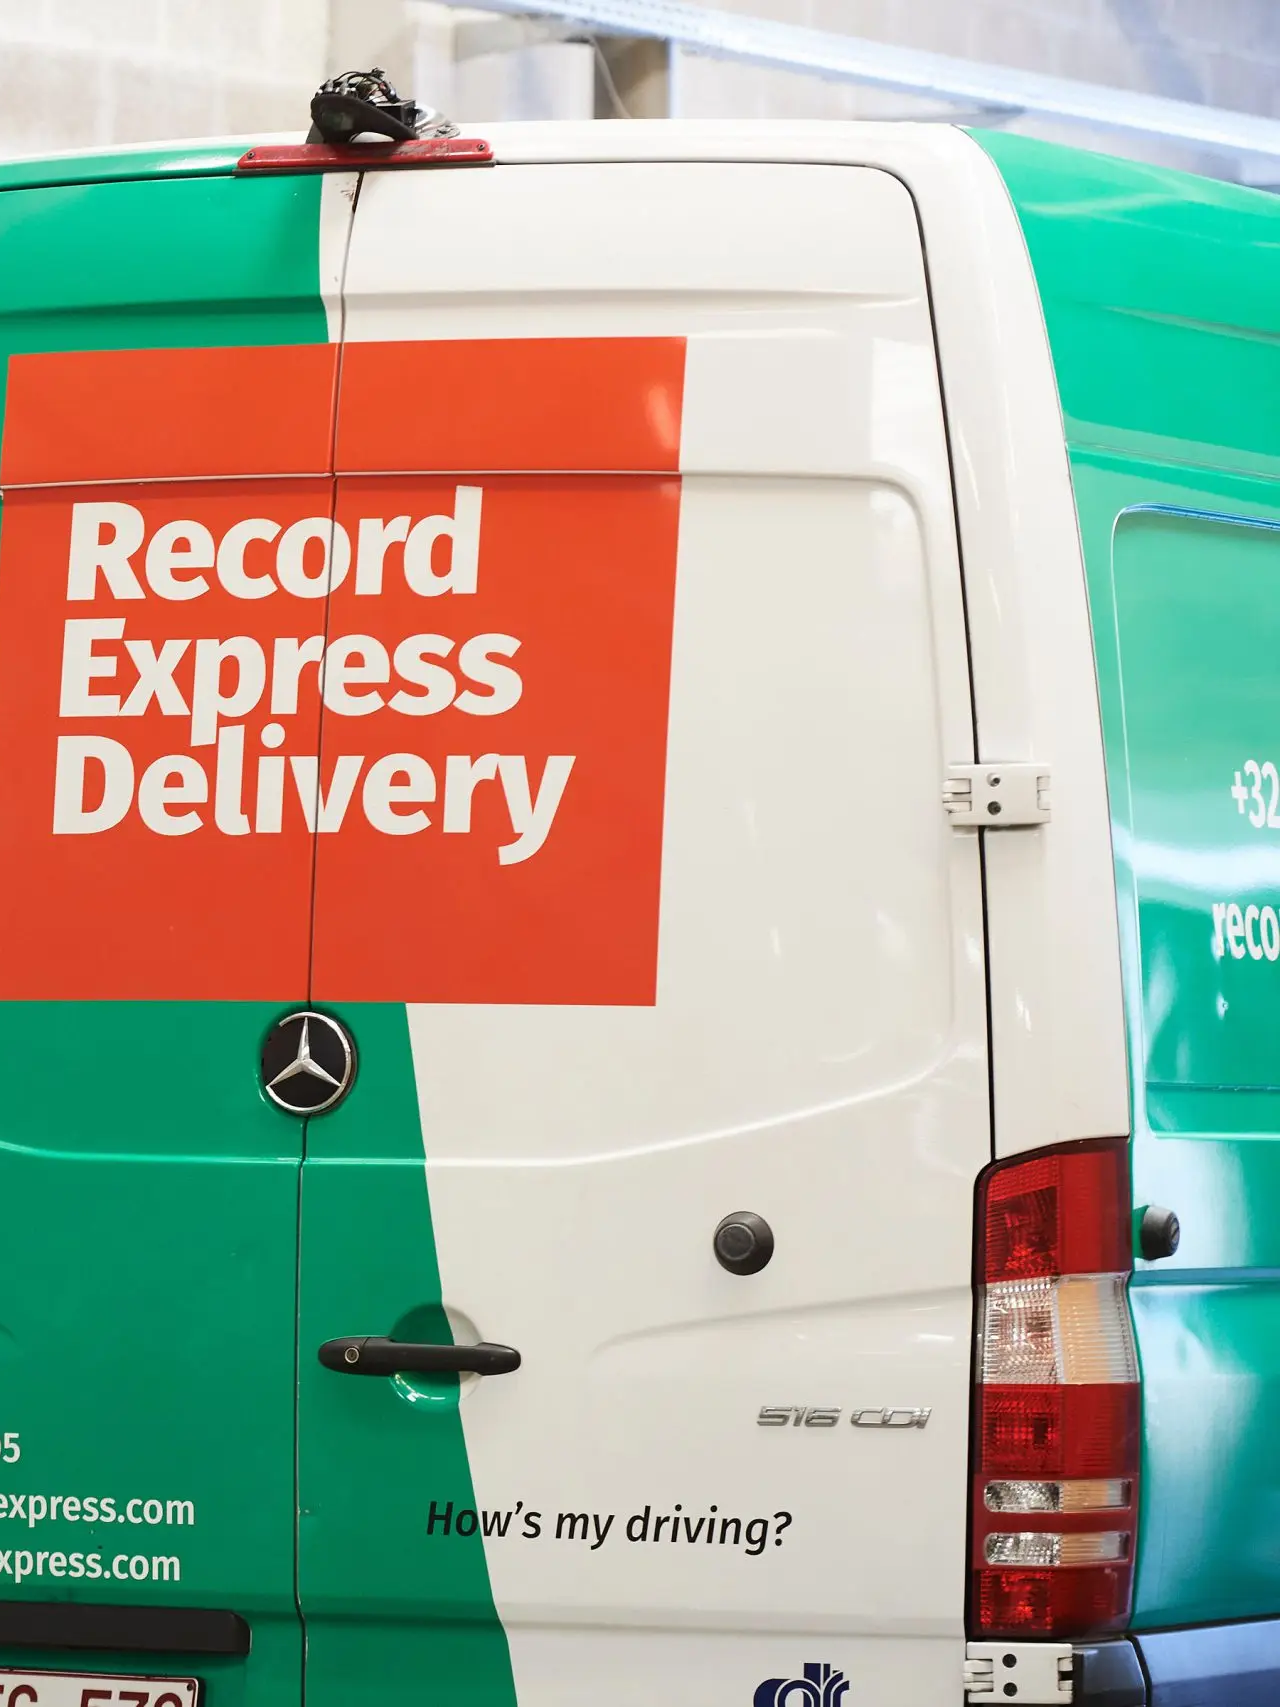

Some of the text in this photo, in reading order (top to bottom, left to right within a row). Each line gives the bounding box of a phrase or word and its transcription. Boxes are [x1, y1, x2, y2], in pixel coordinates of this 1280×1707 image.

[66, 486, 483, 601] Record
[58, 617, 523, 747] Express
[52, 722, 577, 866] Delivery
[1231, 759, 1280, 829] +32
[756, 1406, 932, 1430] 516 CDI
[426, 1500, 793, 1556] How’s my driving?
